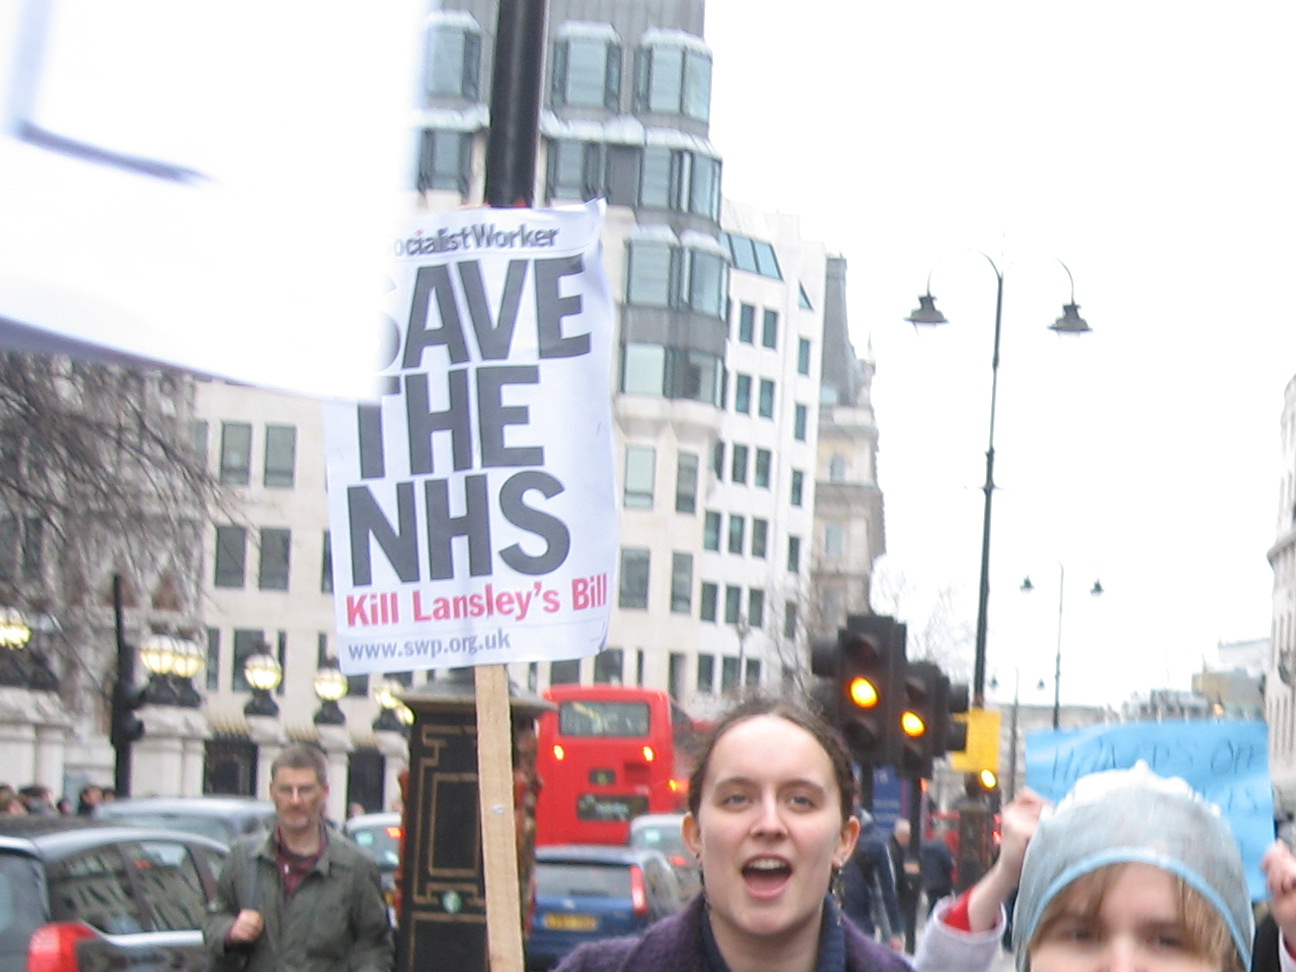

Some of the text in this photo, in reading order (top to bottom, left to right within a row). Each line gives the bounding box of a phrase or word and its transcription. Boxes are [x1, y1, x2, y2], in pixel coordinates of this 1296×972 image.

[347, 471, 571, 586] NHS
[346, 572, 607, 627] Kill Lansley's Bill
[348, 628, 510, 660] www.swp.org.uk
